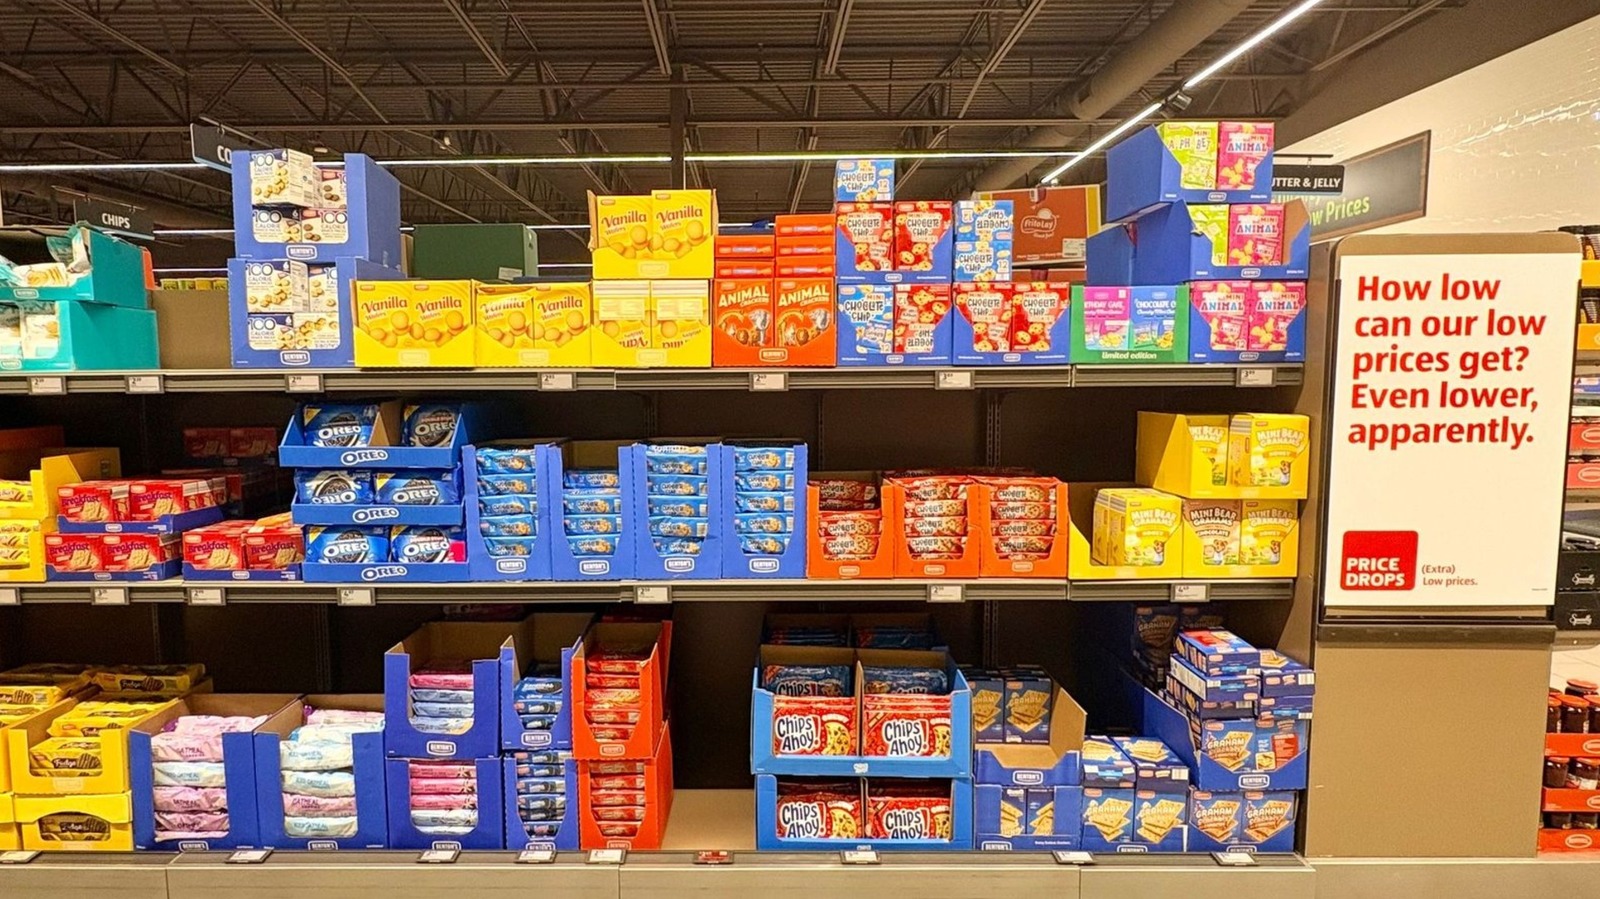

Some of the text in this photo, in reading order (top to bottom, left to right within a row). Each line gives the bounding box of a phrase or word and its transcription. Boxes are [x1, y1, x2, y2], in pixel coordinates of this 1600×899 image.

[1228, 142, 1267, 151] ANIMAL
[1303, 177, 1311, 188] &
[1313, 177, 1342, 188] JELLY
[656, 205, 703, 223] Vanilla
[1326, 195, 1370, 223] Prices
[102, 213, 131, 229] CHIPS
[252, 210, 282, 224] 100
[320, 212, 348, 225] 100
[601, 210, 647, 228] Vanilla
[1237, 224, 1277, 233] ANIMAL
[246, 262, 274, 277] 100
[1357, 273, 1501, 301] How low
[719, 285, 769, 307] ANIMAL
[778, 285, 830, 307] ANIMAL
[361, 296, 408, 313] Vanilla
[416, 296, 462, 313] Vanilla
[538, 296, 583, 313] Vanilla
[1201, 301, 1244, 310] ANIMAL
[1257, 301, 1299, 310] ANIMAL
[248, 317, 276, 332] 100
[1354, 308, 1547, 337] can our low
[1353, 344, 1530, 379] prices get?
[1351, 381, 1538, 413] Even lower,
[318, 425, 361, 439] OREO
[415, 421, 456, 435] OREO
[1257, 428, 1304, 441] MINI BEAR
[1348, 416, 1534, 450] apparently.
[341, 450, 388, 465] OREO
[312, 491, 356, 504] OREO
[393, 489, 439, 503] OREO
[352, 507, 399, 523] OREO
[1131, 508, 1178, 521] MINI BEAR
[1190, 508, 1238, 521] MINI BEAR
[1247, 509, 1294, 521] MINI BEAR
[324, 542, 369, 557] OREO
[404, 541, 450, 556] OREO
[1346, 557, 1400, 572] PRICE
[1421, 564, 1456, 575] (Extra)
[361, 565, 408, 581] OREO
[1345, 573, 1405, 587] DROPS
[1422, 576, 1478, 588] Low prices.
[777, 716, 813, 738] Chips
[885, 720, 920, 742] Chips
[1207, 738, 1245, 749] GRAHAM
[782, 803, 818, 825] Chips
[886, 809, 921, 830] Chips
[1195, 807, 1232, 818] GRAHAM
[1247, 807, 1284, 818] GRAHAM
